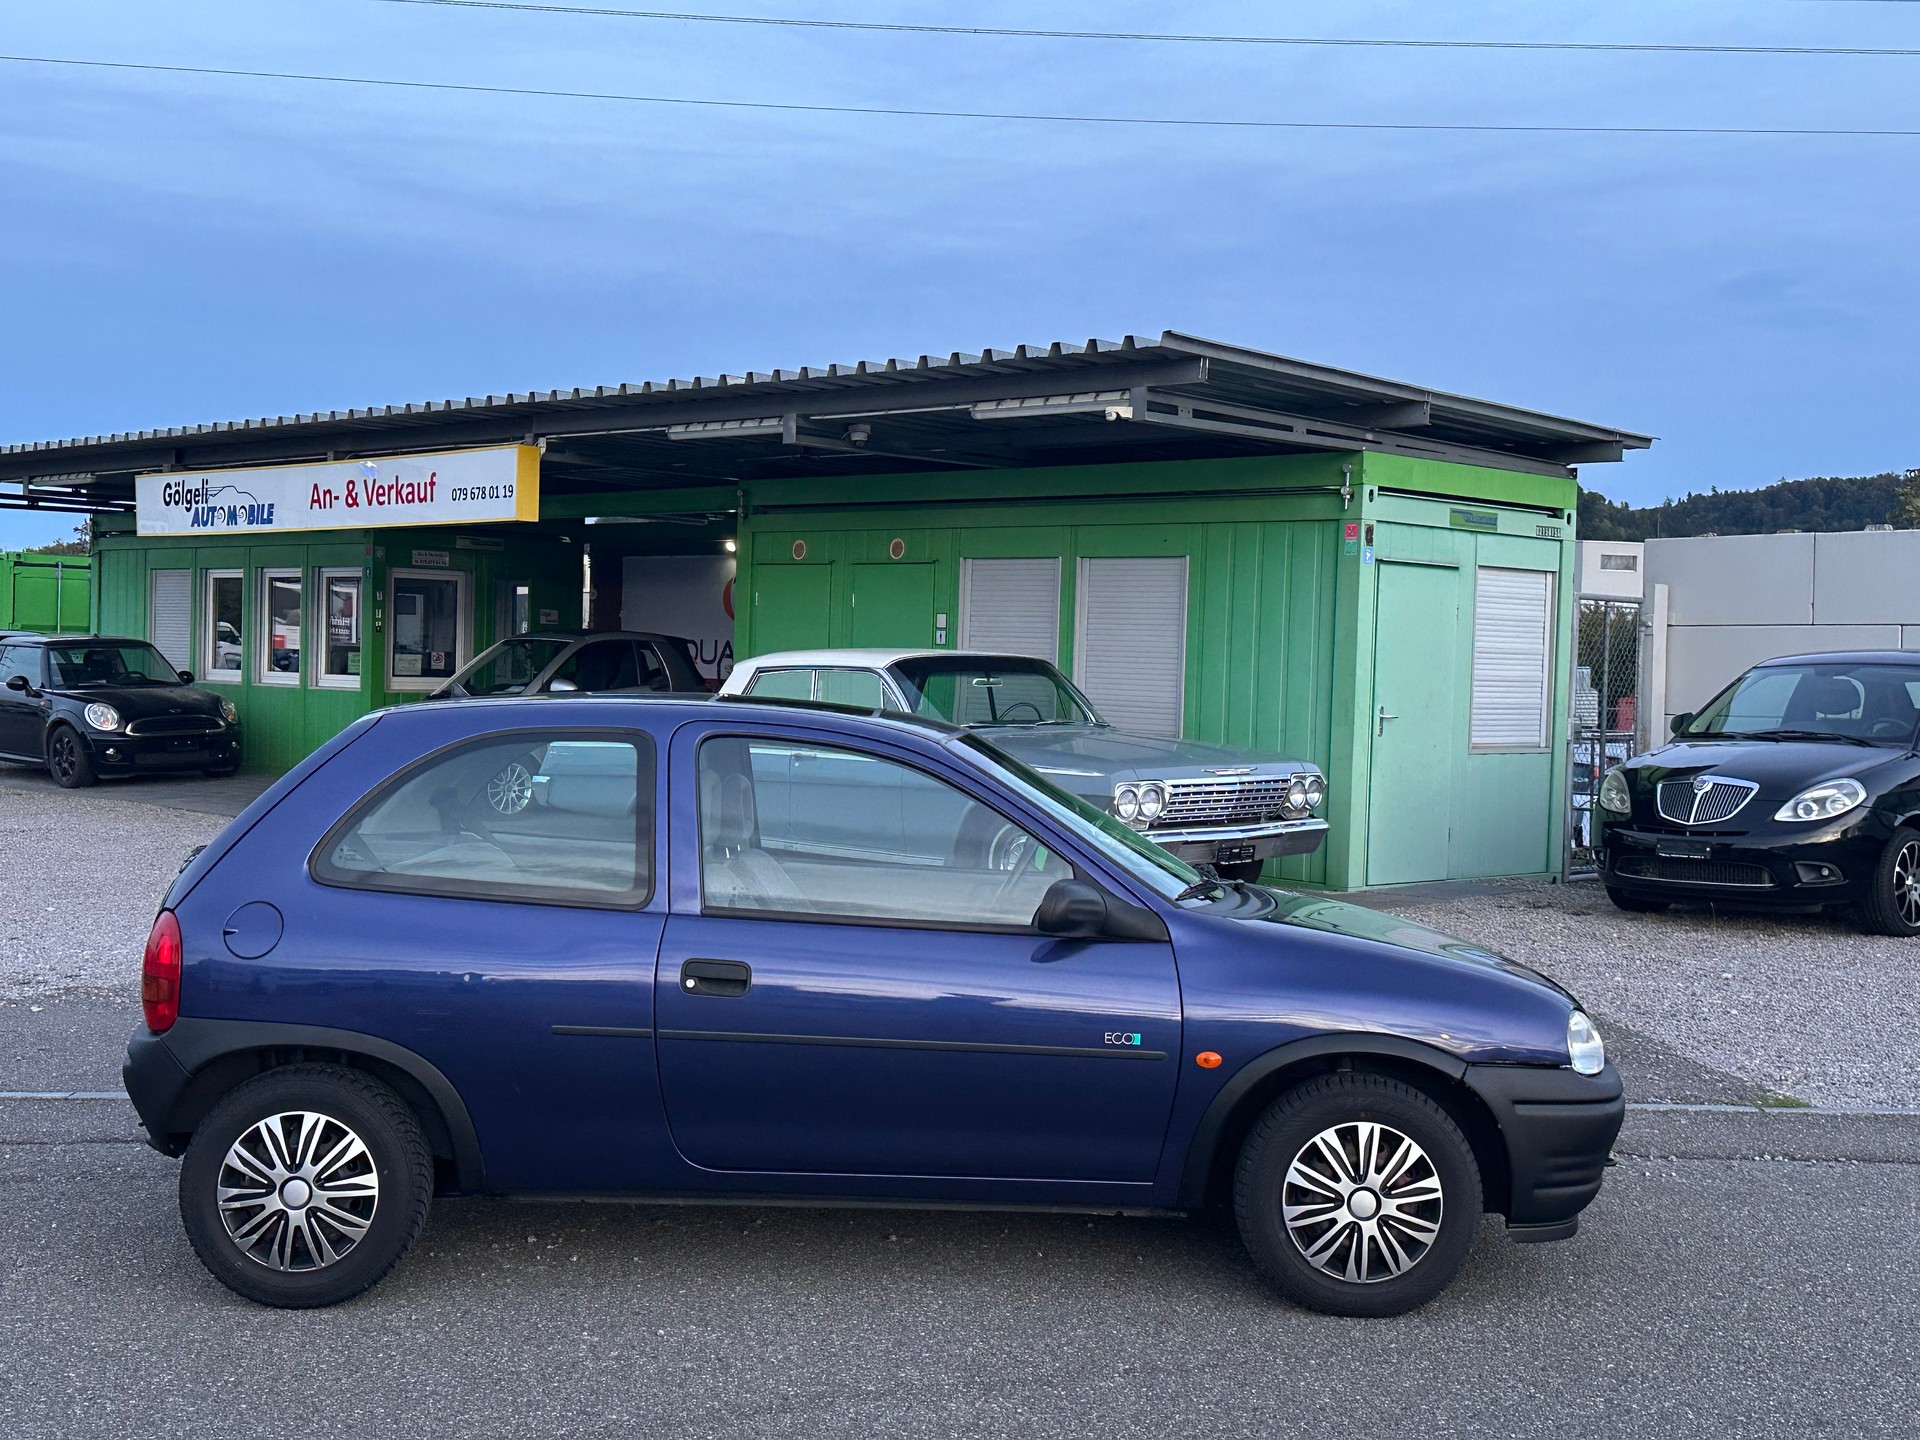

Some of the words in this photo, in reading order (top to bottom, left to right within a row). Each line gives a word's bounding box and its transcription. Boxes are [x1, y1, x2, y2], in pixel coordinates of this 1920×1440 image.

[163, 478, 209, 513] Gölgeli
[310, 482, 340, 510] An-
[345, 479, 360, 508] &
[363, 472, 437, 507] Verkauf
[451, 487, 467, 501] 079
[470, 486, 487, 500] 678
[488, 485, 500, 499] 01
[502, 484, 514, 498] 19
[1104, 1032, 1135, 1045] ECO
